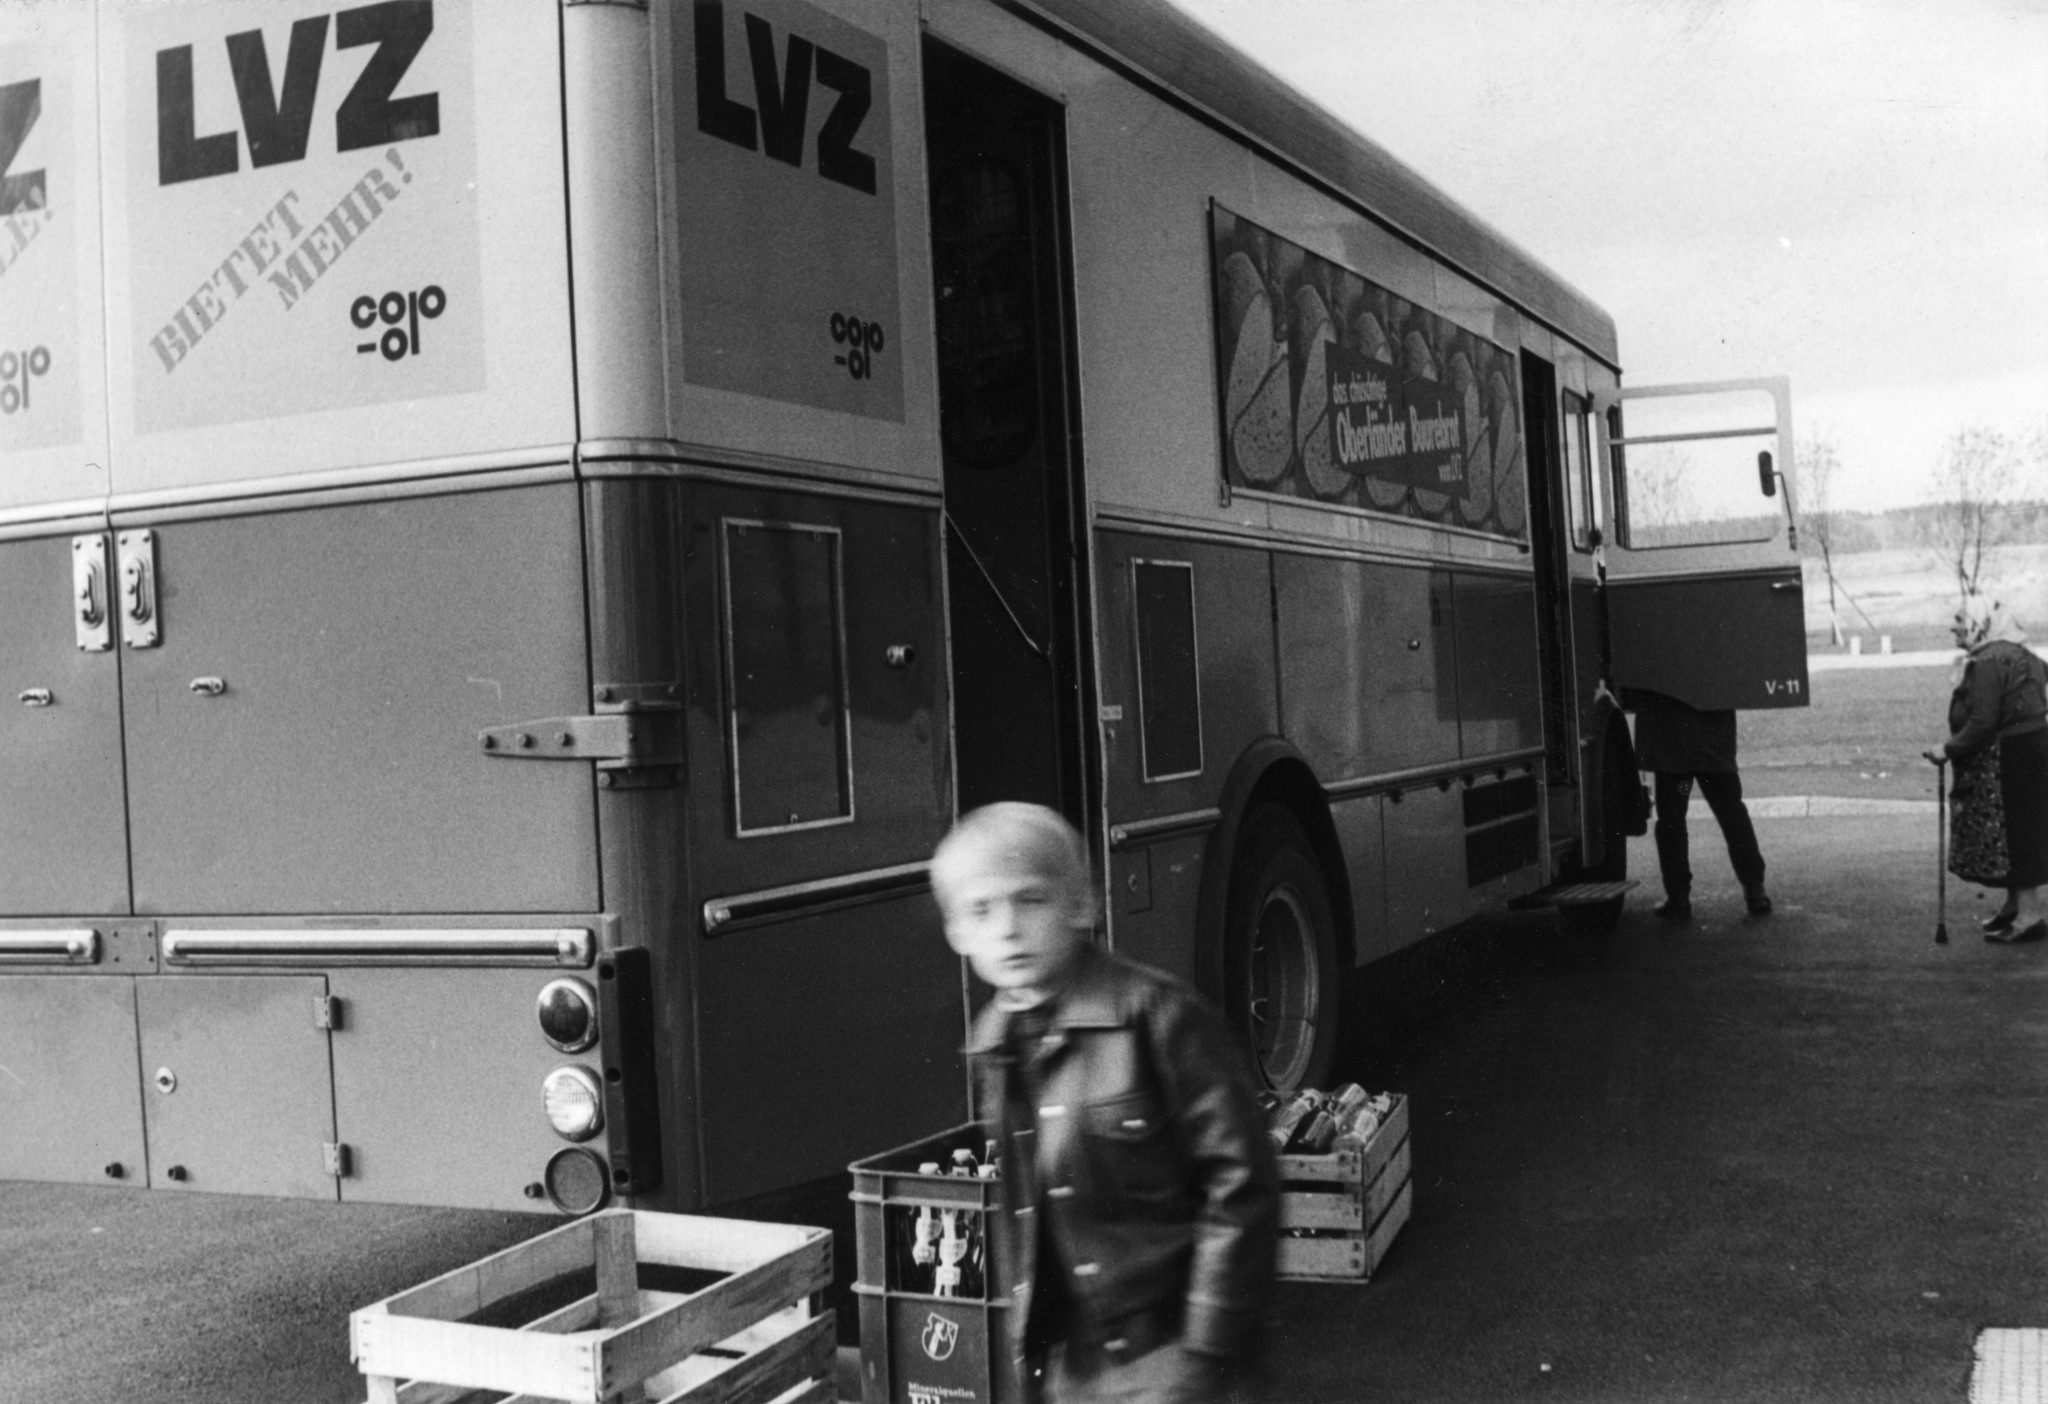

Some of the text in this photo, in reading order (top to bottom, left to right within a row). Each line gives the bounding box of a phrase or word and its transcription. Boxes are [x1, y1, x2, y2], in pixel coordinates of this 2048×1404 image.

[156, 0, 440, 187] LVZ
[693, 0, 877, 197] LVZ
[148, 190, 306, 374] BIETET
[267, 147, 413, 312] MEHR!
[1333, 371, 1348, 405] das
[1336, 403, 1406, 464] Oberländer
[1765, 679, 1799, 695] V-11
[908, 1381, 976, 1400] Mineralquellen
